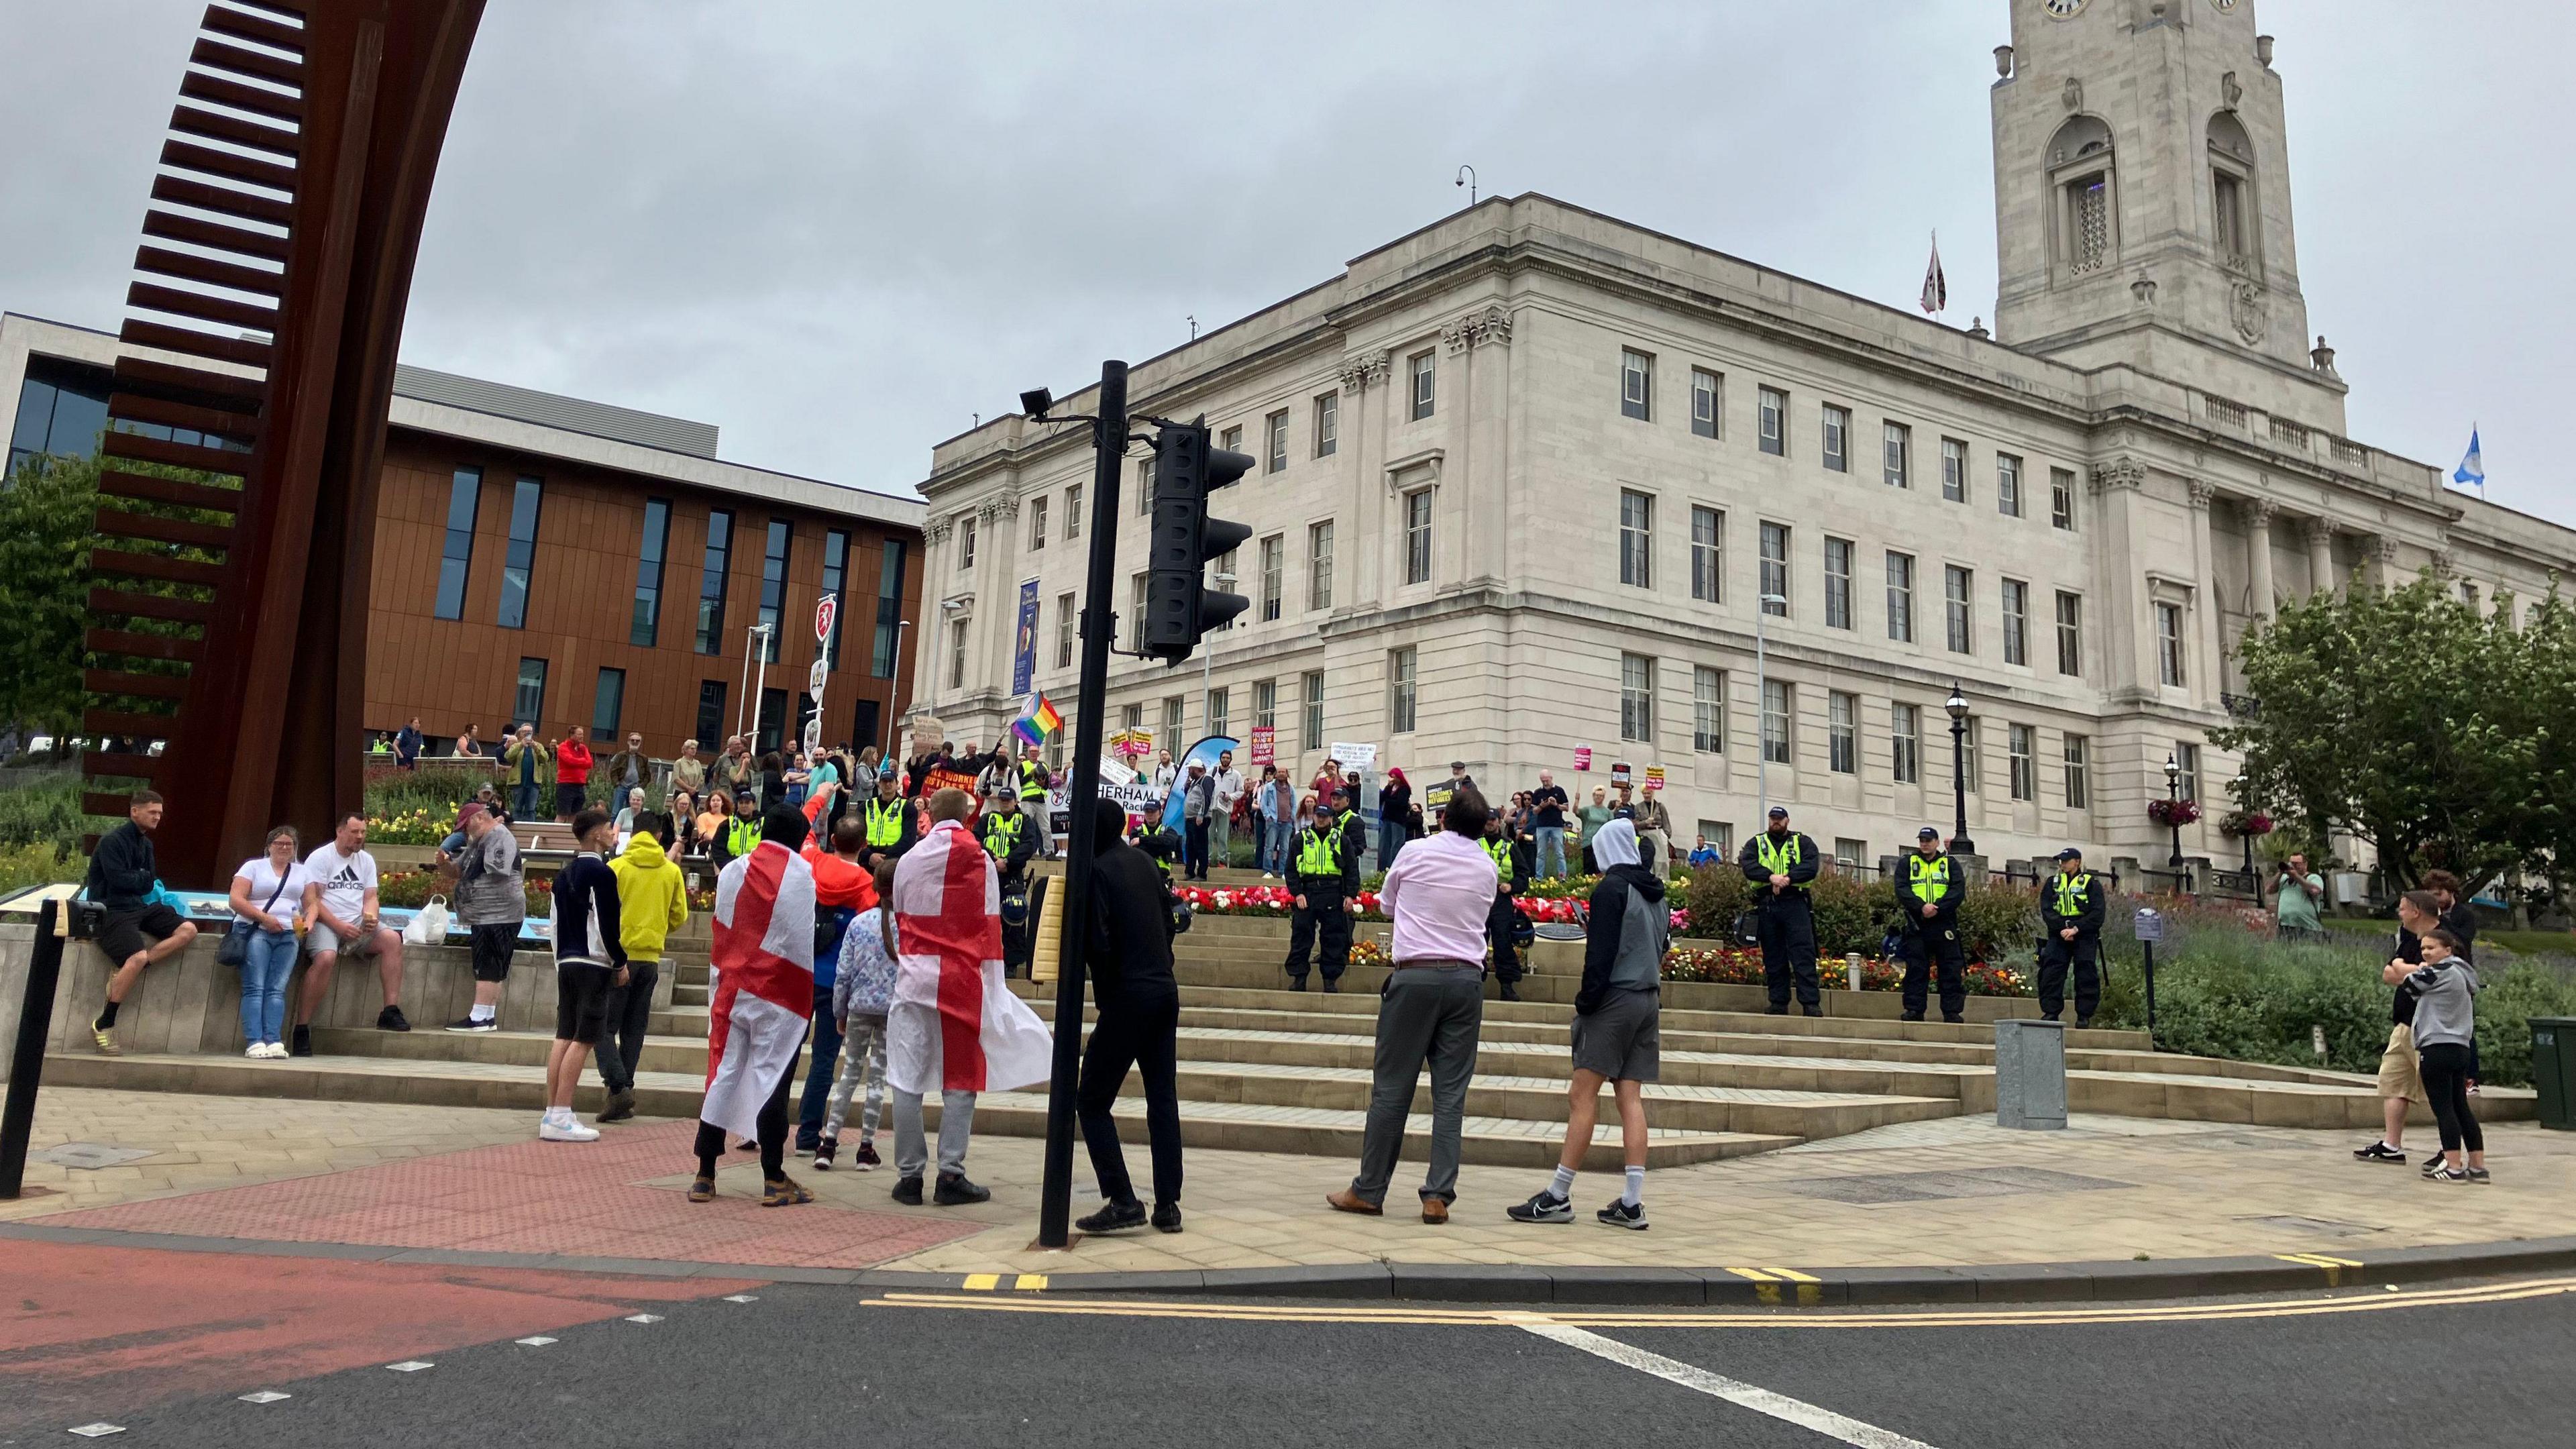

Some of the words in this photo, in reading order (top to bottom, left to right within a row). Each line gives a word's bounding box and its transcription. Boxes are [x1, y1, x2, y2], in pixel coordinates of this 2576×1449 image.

[1428, 789, 1453, 798] WELCOMES
[1428, 795, 1451, 804] REFUGEES
[328, 879, 365, 891] adidas
